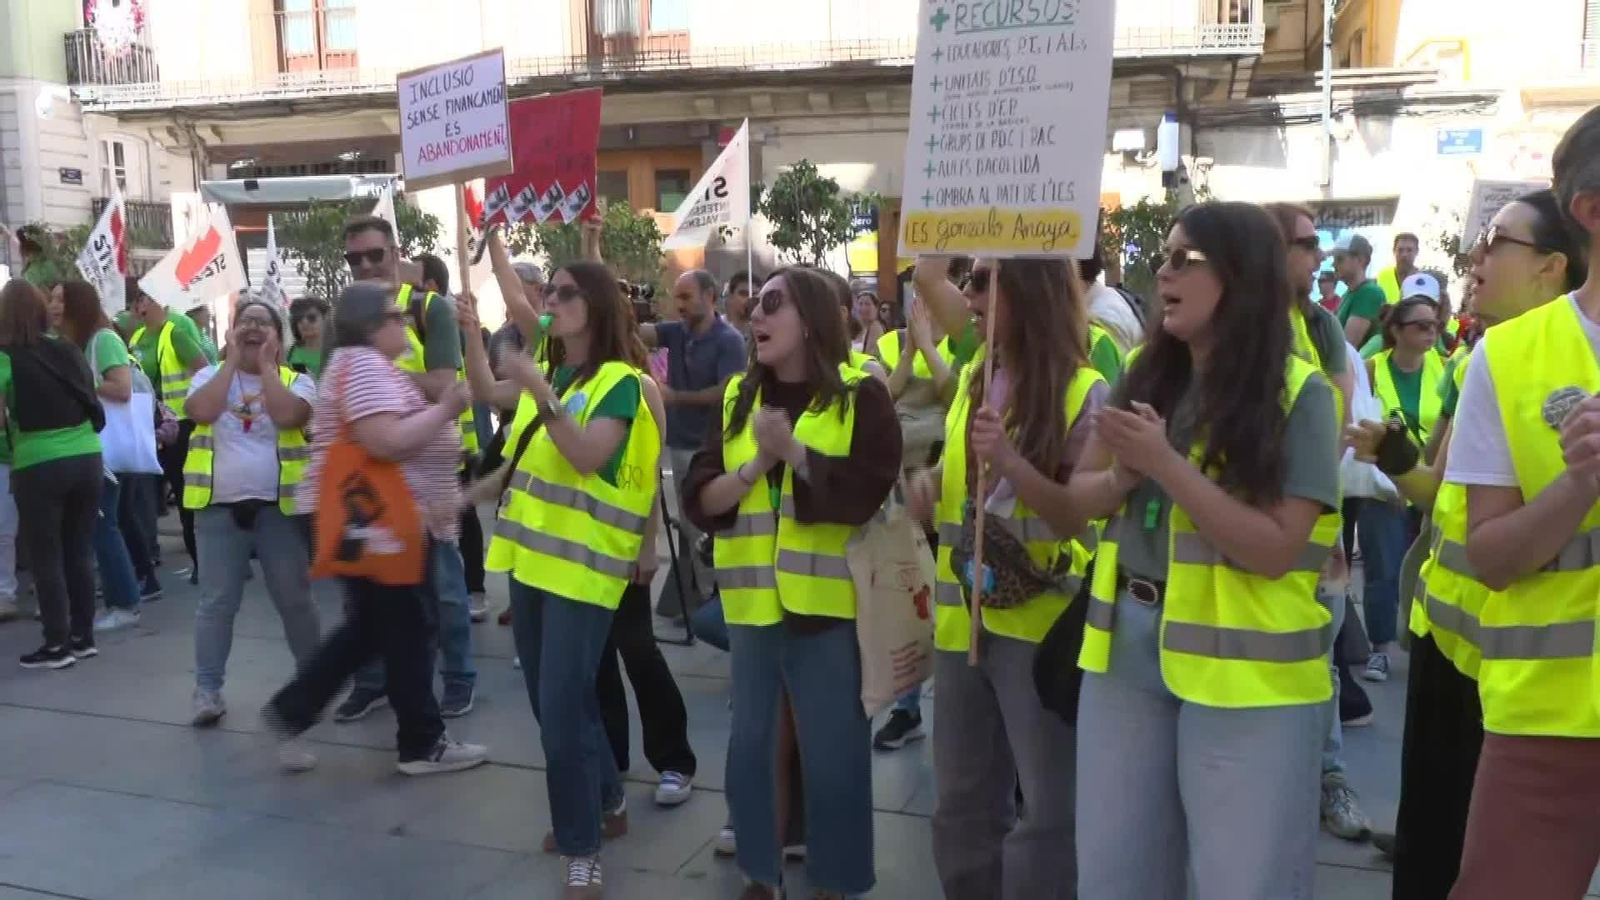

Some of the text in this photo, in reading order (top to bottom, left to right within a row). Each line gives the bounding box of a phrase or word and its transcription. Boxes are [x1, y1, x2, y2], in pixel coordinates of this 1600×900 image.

[407, 103, 440, 130] SENSE
[935, 185, 974, 206] OMBRA
[979, 185, 990, 204] AL
[1026, 181, 1037, 202] DE
[904, 220, 928, 245] IES
